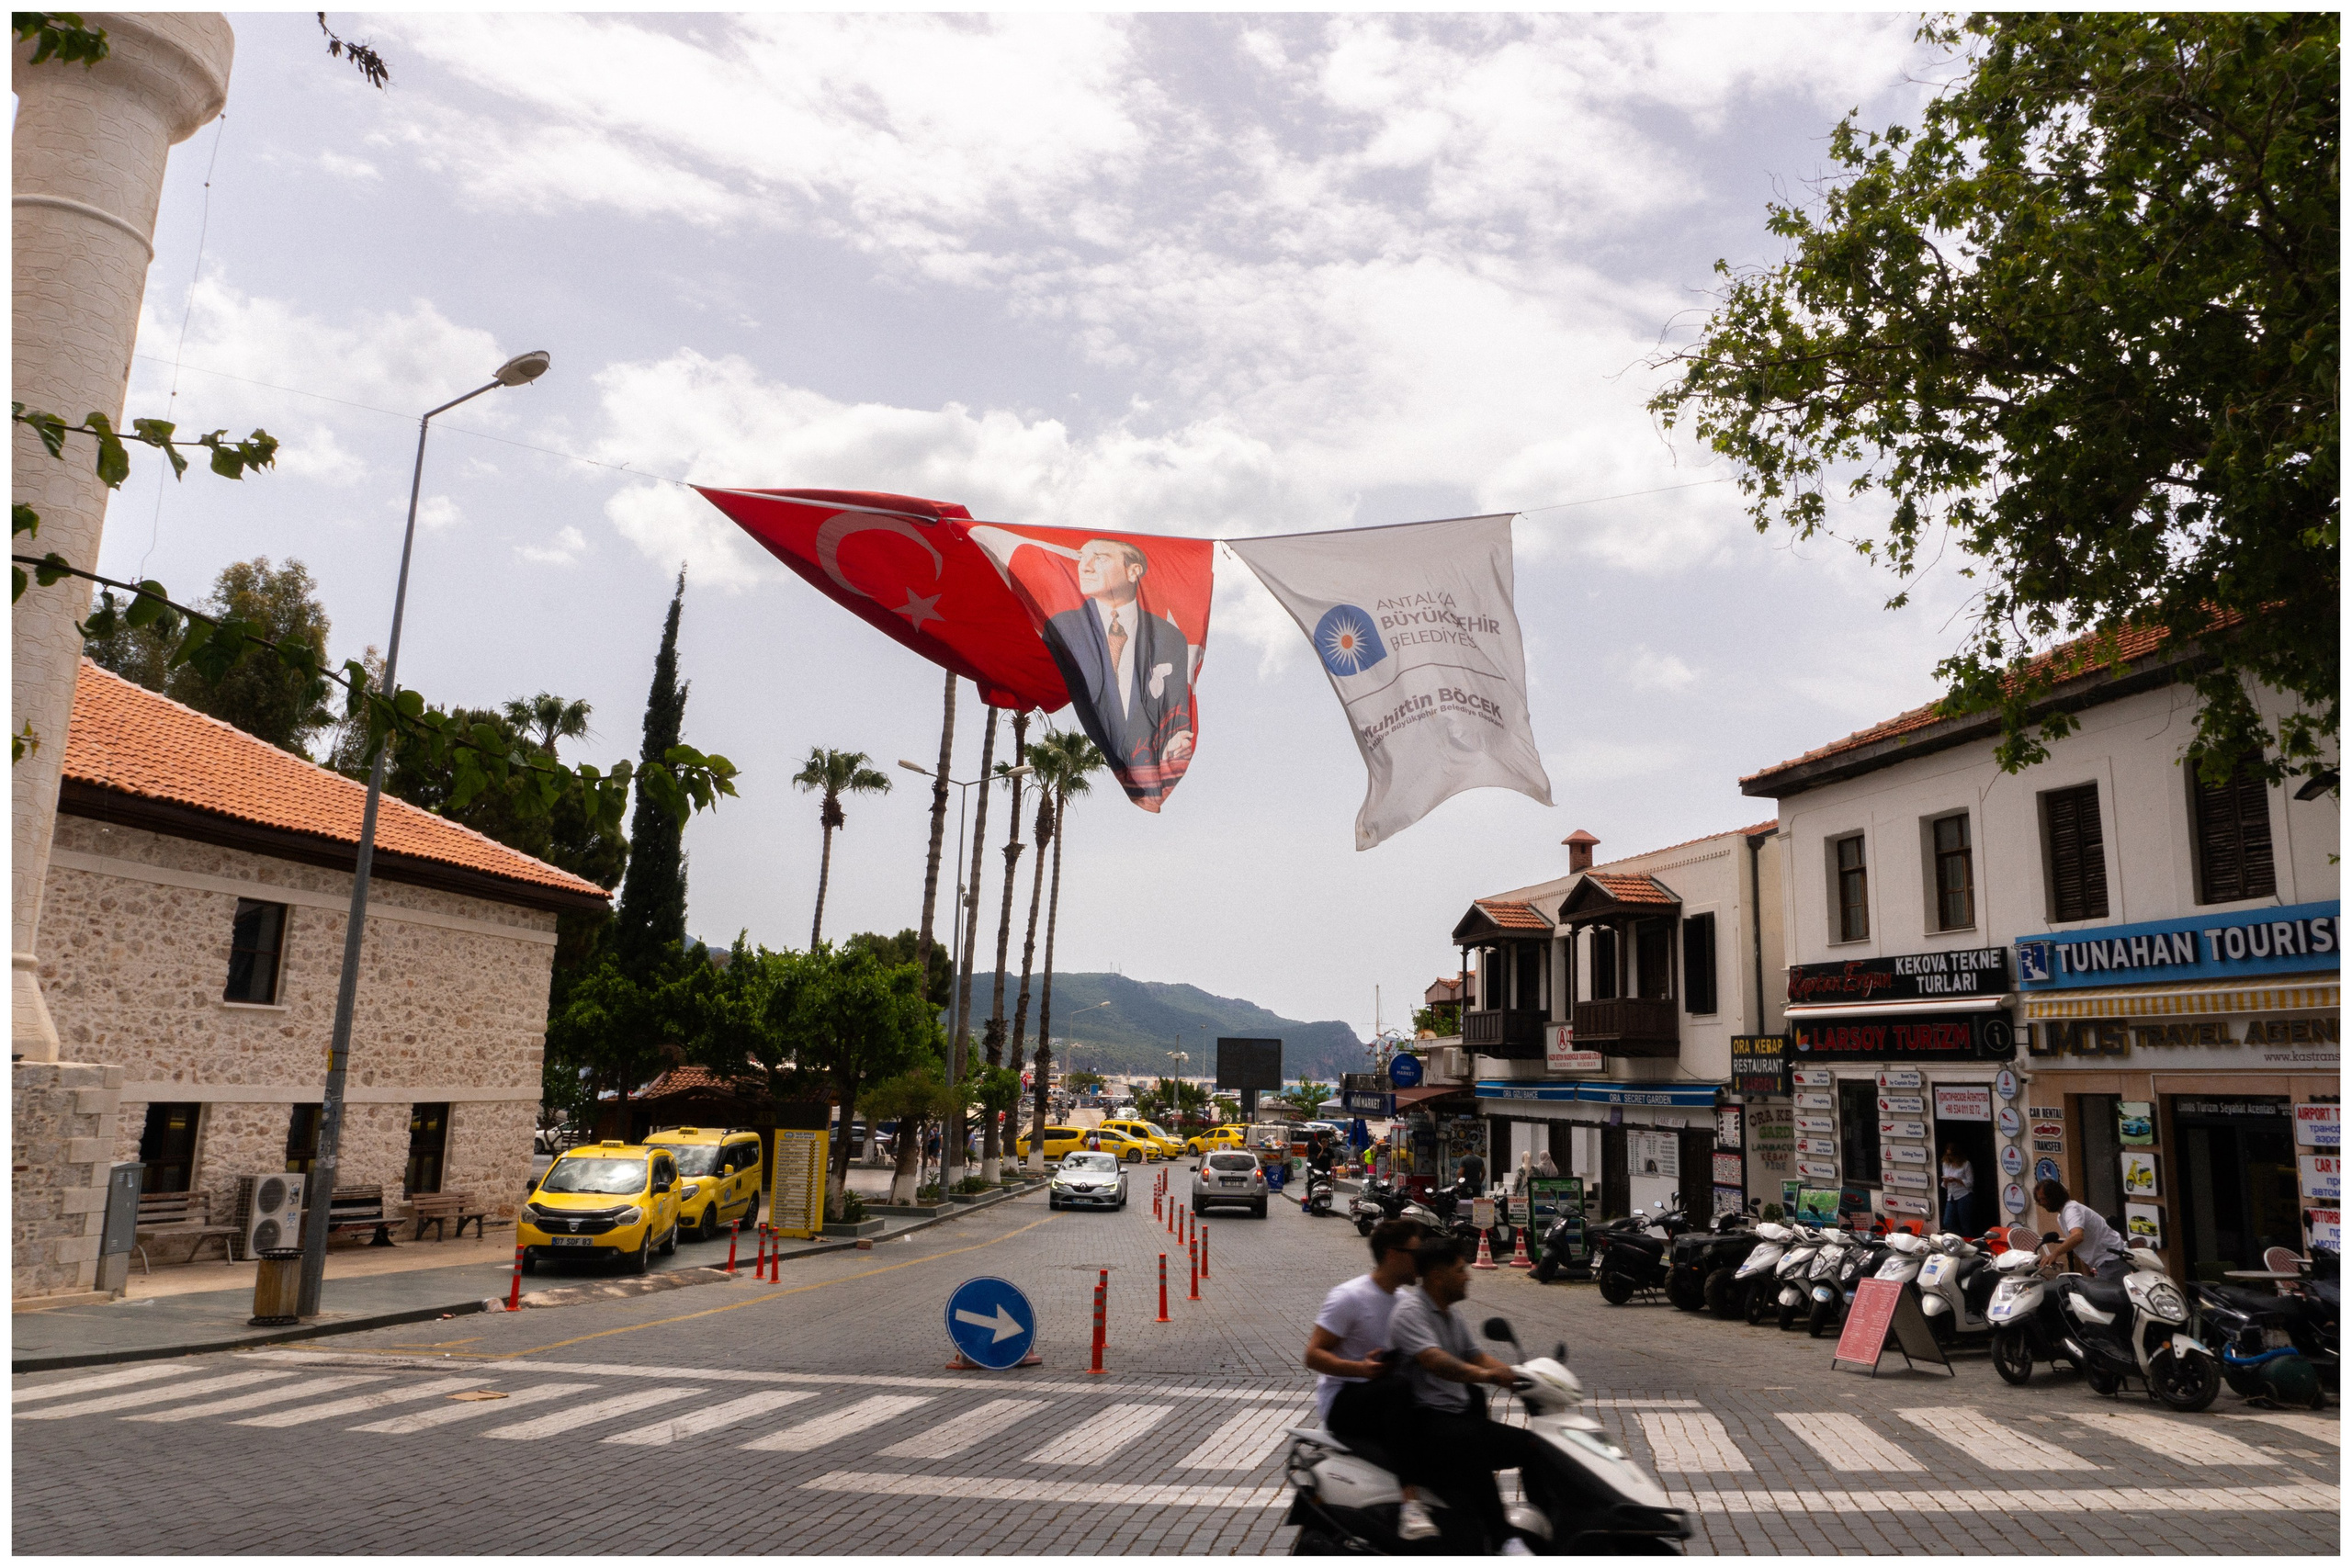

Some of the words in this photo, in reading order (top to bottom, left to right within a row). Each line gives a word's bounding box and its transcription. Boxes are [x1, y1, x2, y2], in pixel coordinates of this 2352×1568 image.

[1380, 606, 1501, 635] BÜYÜKŞEHİR
[1360, 694, 1433, 745] Muhittin
[1369, 731, 1390, 752] Antalya
[1391, 708, 1438, 733] Büyükşehir
[1440, 704, 1476, 716] Belediye
[1477, 711, 1505, 729] Başkanı
[2055, 931, 2198, 974] TUNAHAN
[2203, 915, 2340, 963] TOURIS
[1895, 953, 1947, 976] KEKOVA
[1950, 949, 2001, 970] TEKNE
[1788, 967, 1840, 1000] Kaptan
[1842, 962, 1893, 998] Ergun
[1917, 972, 1977, 994] TURLARI
[1813, 1026, 1887, 1052] LARSOY
[2128, 1021, 2240, 1048] TRAVEL
[2244, 1018, 2340, 1046] AGEN
[1733, 1039, 1750, 1055] ORA
[1755, 1039, 1783, 1055] KEBAP
[1733, 1058, 1784, 1073] RESTAURANT
[1743, 1077, 1775, 1091] GARDEN
[1502, 1089, 1511, 1099] ORA
[1609, 1093, 1622, 1102] ORA
[1623, 1093, 1646, 1103] SECRET
[1646, 1094, 1672, 1104] GARDEN
[1937, 1089, 1966, 1104] Туристическое
[1966, 1089, 1988, 1102] Агентство
[1361, 1097, 1380, 1110] MARKET
[2220, 1102, 2246, 1115] Seyahat
[1749, 1110, 1773, 1127] ORA
[1776, 1110, 1793, 1122] KE
[2029, 1107, 2041, 1118] CAR
[2041, 1108, 2064, 1119] RENTAL
[2298, 1106, 2331, 1121] AIRPORT
[1657, 1116, 1670, 1125] TAKE
[1671, 1117, 1686, 1127] AWAY
[2033, 1139, 2063, 1152] TRANSFER
[1760, 1152, 1788, 1161] KEBAP
[2314, 1157, 2333, 1173] CAR
[555, 1237, 564, 1246] 07
